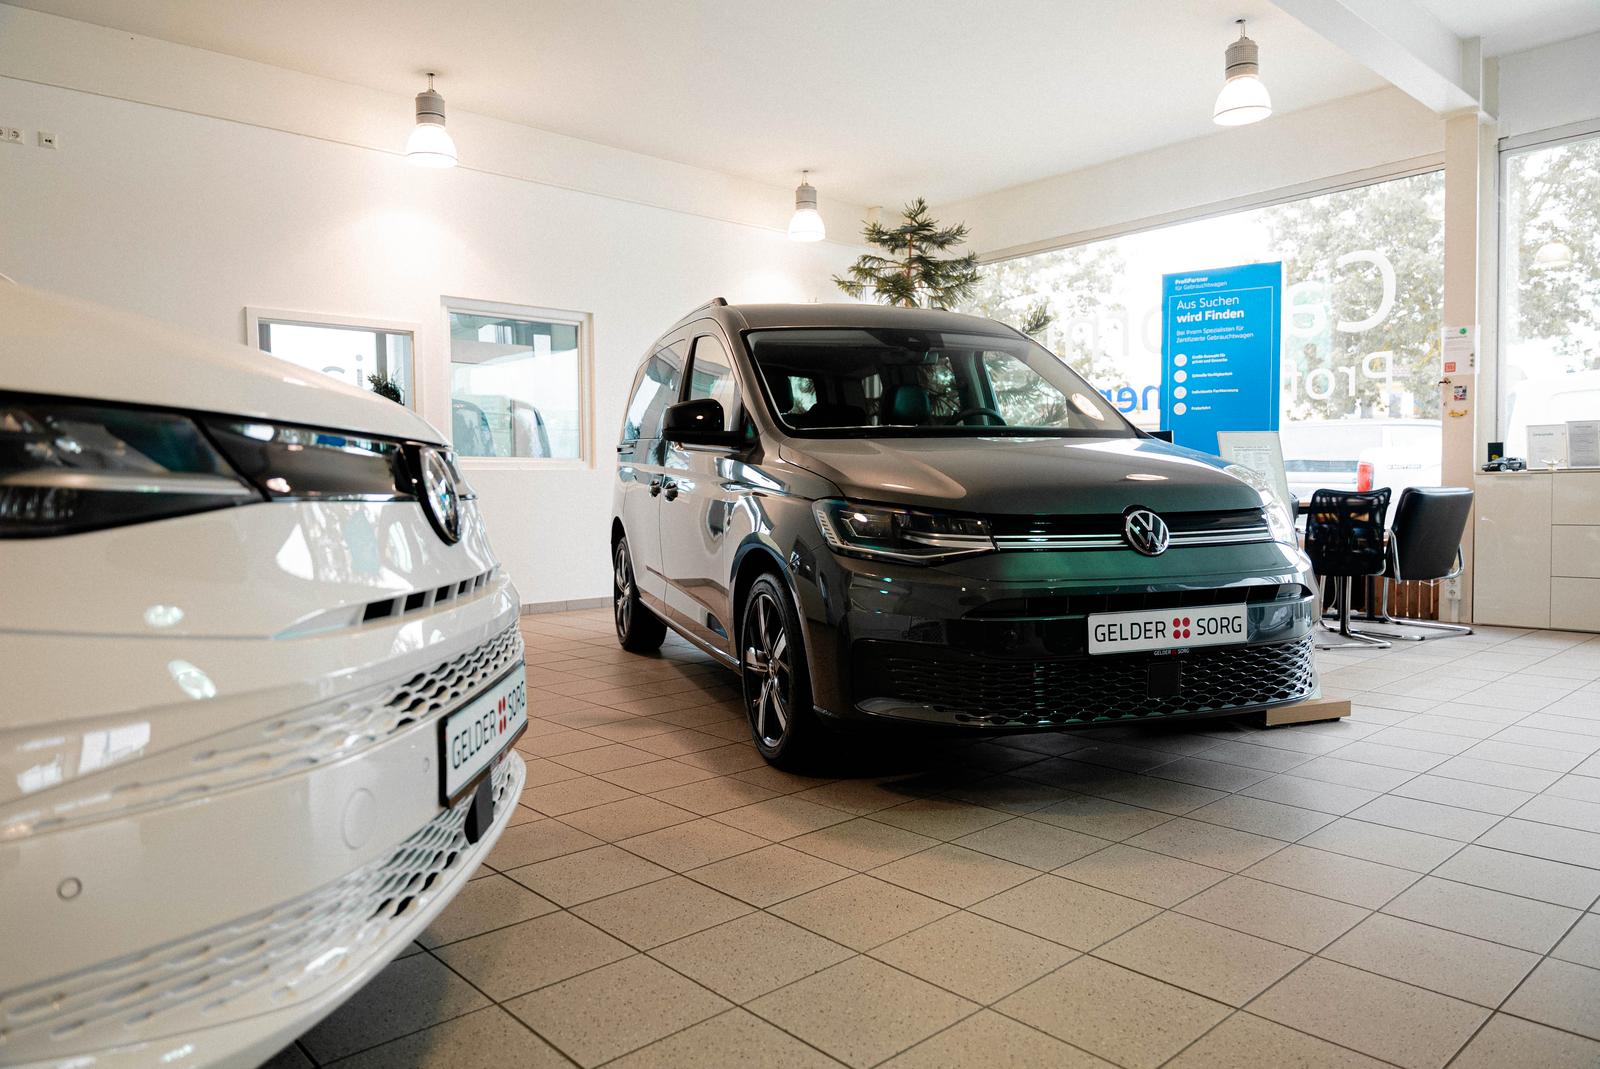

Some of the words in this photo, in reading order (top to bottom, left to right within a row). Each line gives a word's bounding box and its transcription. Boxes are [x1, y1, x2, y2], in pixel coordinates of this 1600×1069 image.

[1177, 299, 1197, 310] Aus
[1200, 296, 1240, 308] Suchen
[1176, 311, 1203, 323] wird
[1205, 309, 1245, 321] Finden
[1094, 620, 1167, 643] GELDER
[1196, 615, 1243, 636] SORG
[452, 709, 497, 770] GELDER
[508, 680, 526, 721] SORG
